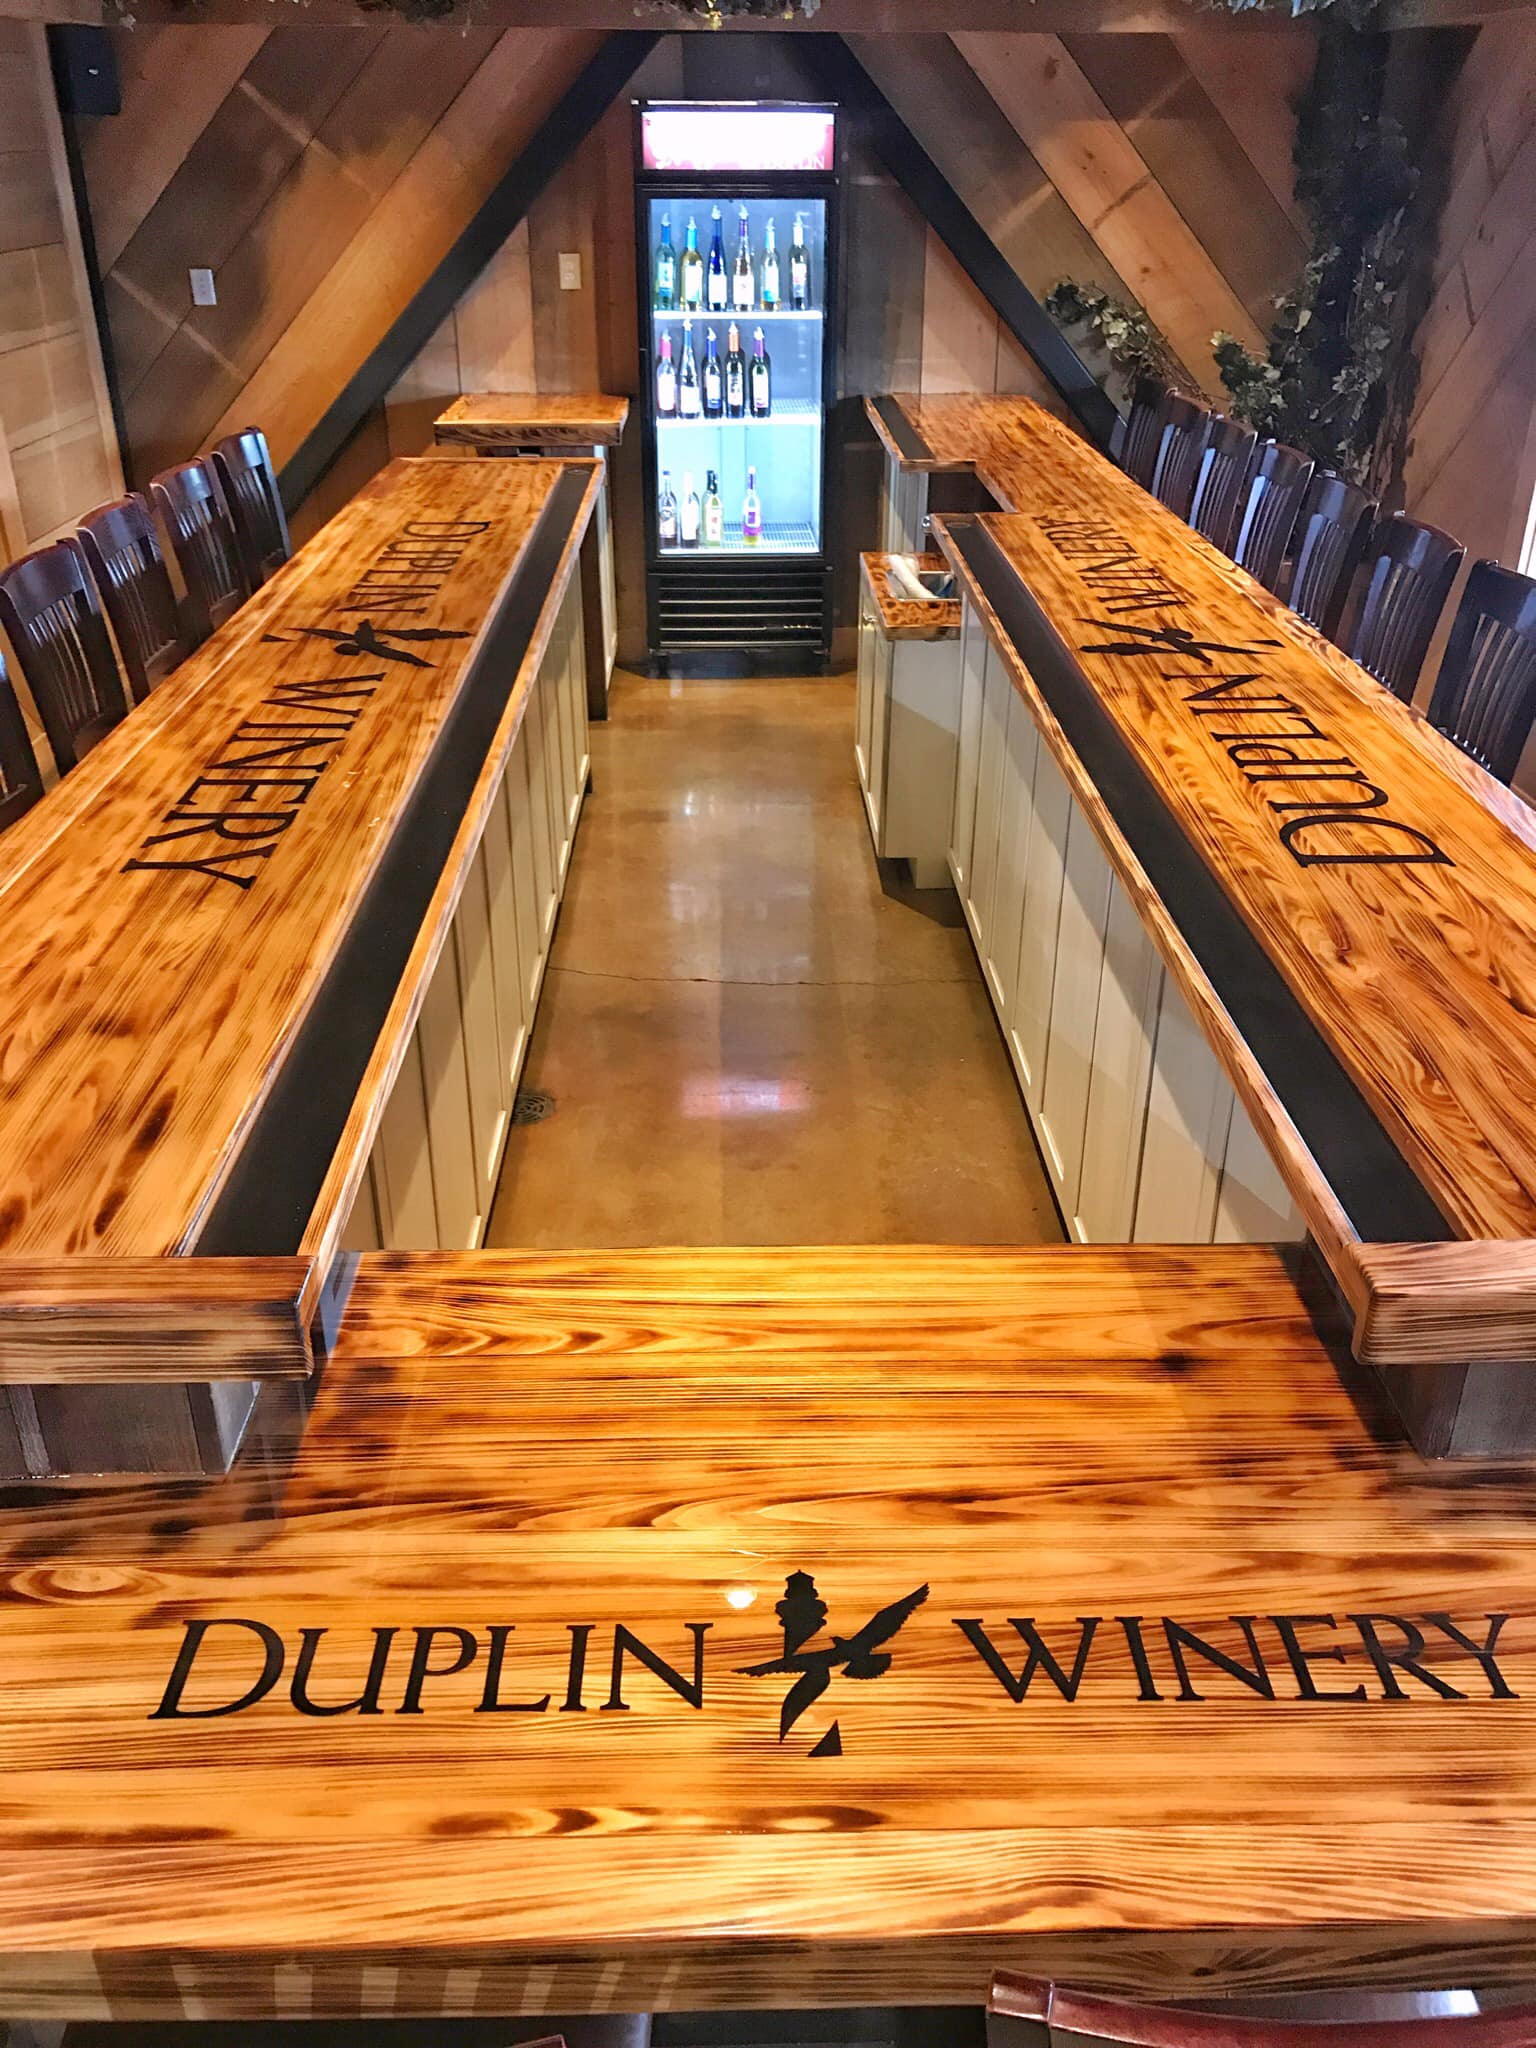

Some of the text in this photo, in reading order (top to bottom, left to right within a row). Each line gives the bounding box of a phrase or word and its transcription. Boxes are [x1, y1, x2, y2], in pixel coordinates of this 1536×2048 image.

[120, 521, 491, 889] DUPLIN WINERY
[1032, 515, 1457, 868] DUPLIN WINERY
[147, 1613, 1521, 1719] DUPLIN WINERY
